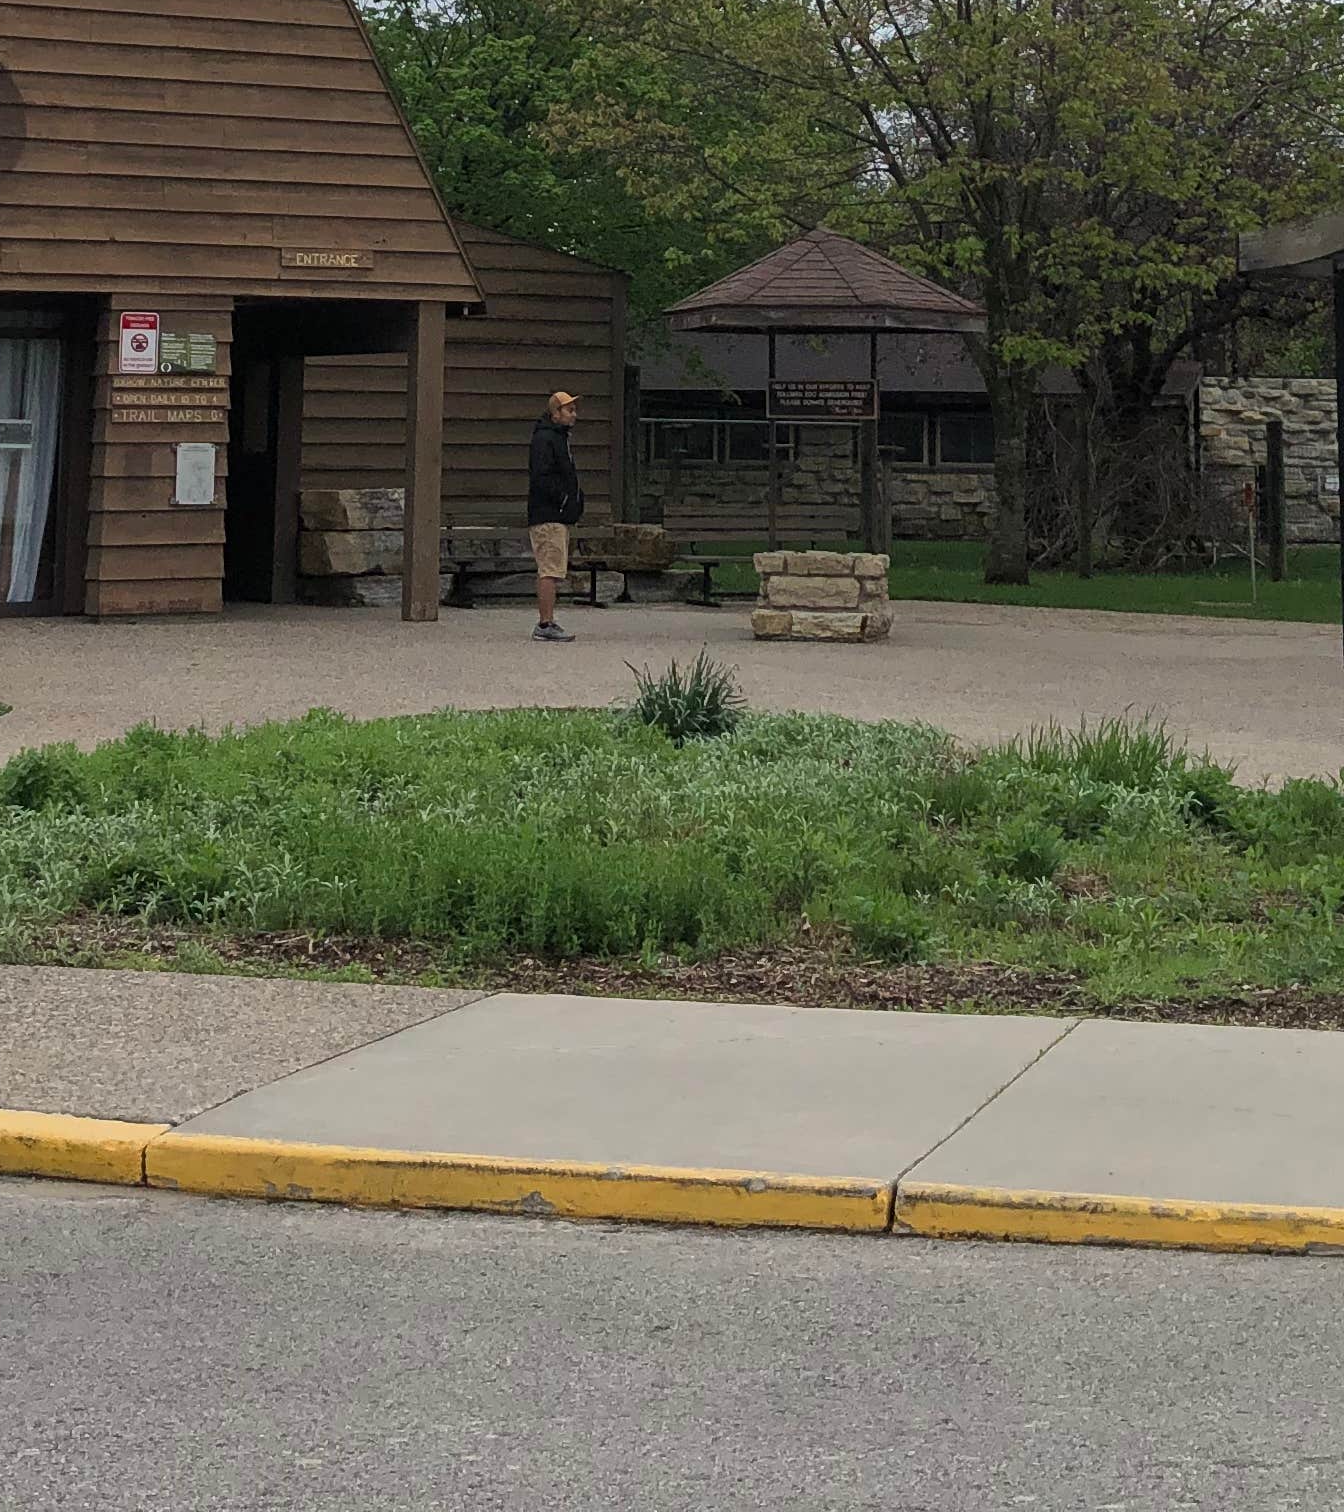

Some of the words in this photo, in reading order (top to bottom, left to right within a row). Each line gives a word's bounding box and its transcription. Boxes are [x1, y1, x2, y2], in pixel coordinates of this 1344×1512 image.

[296, 252, 359, 267] ENTRANCE
[122, 393, 147, 403] OPEN
[150, 393, 176, 404] DAILY
[196, 394, 208, 404] TO
[121, 409, 160, 421] TRAIL
[167, 410, 203, 422] MAPS
